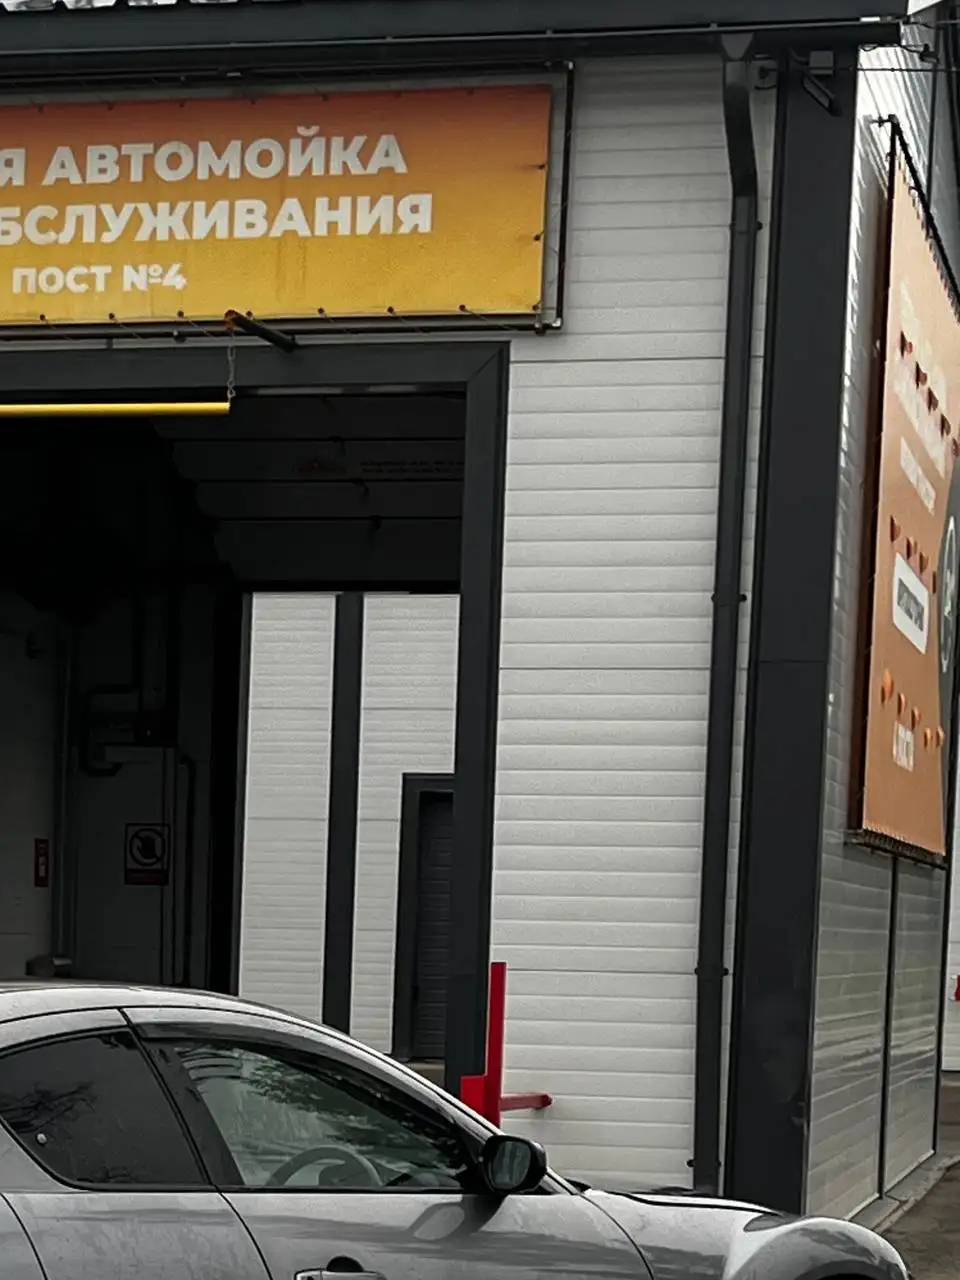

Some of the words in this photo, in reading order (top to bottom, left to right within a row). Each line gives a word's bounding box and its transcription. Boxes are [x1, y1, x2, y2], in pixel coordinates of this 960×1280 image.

[42, 126, 407, 186] АВТОМОЙКА
[12, 265, 113, 294] ПОСТ
[122, 263, 188, 292] №4
